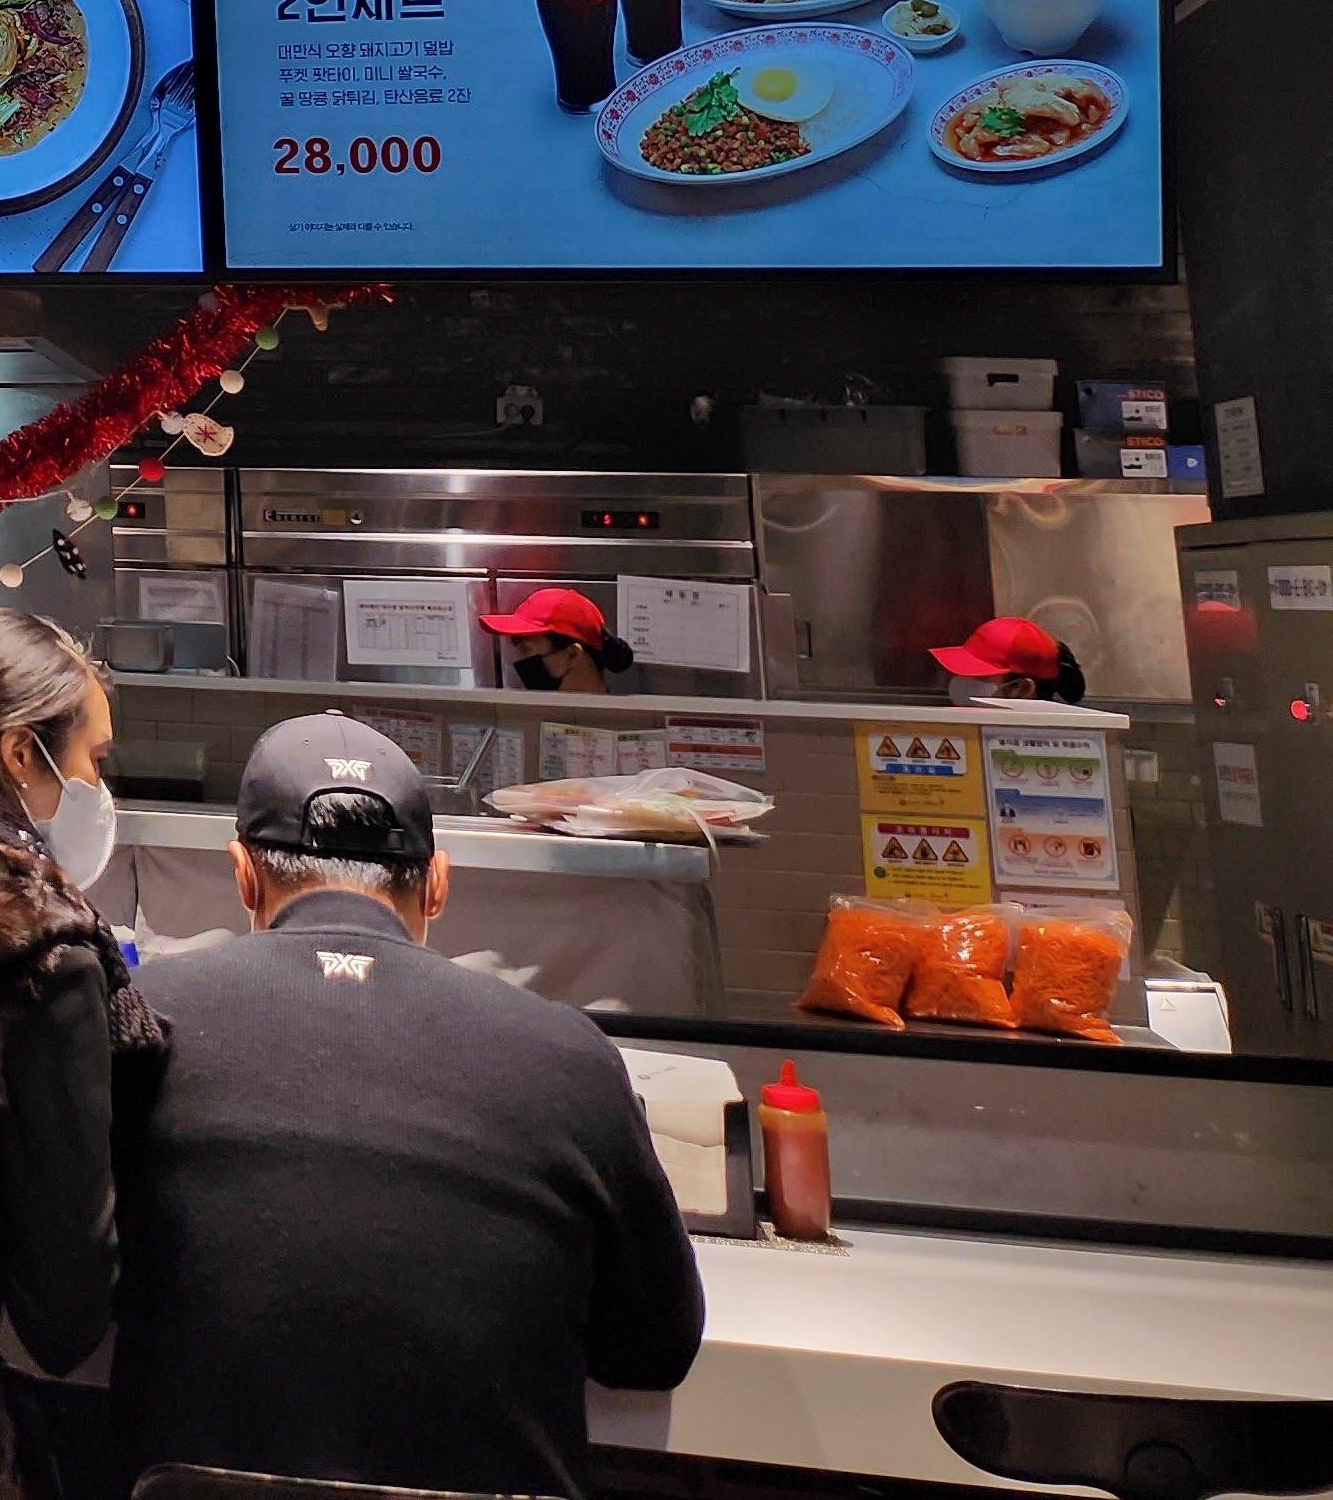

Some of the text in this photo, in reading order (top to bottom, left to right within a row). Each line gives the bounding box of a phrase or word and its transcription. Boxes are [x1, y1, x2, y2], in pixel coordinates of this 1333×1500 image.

[277, 40, 455, 60] 대만식 오향 돼지고기 덮밥
[279, 64, 447, 83] 푸켓 팟타이, 미니 쌀국수,
[279, 87, 472, 107] 꿀 땅콩 닭튀김, 탄산음료 2잔
[273, 135, 441, 176] 28,000
[1128, 389, 1165, 400] STICO
[1126, 436, 1165, 447] STICO
[316, 950, 376, 984] PXG
